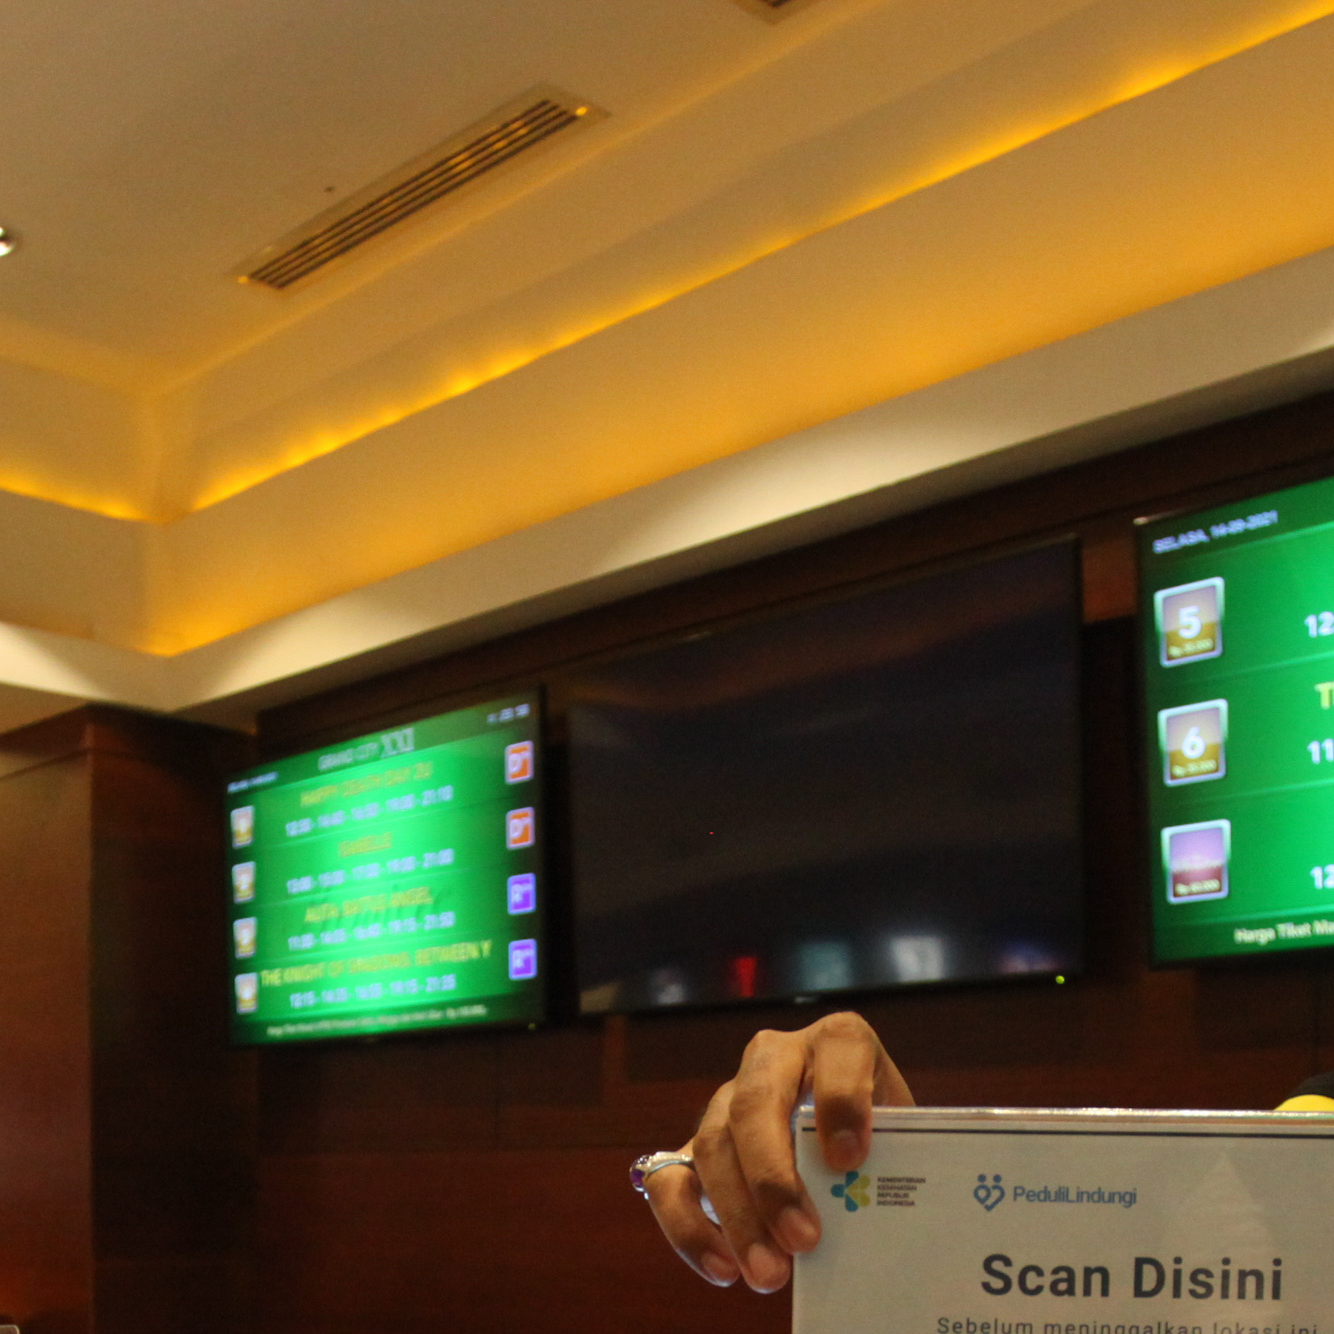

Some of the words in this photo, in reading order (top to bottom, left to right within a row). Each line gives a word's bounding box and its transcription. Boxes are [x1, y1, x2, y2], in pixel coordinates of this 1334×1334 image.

[1178, 605, 1202, 639] 5
[1182, 726, 1207, 759] 6
[1013, 1186, 1137, 1208] PeduliLindungi
[982, 1254, 1110, 1297] Scan
[1133, 1257, 1282, 1300] Disini
[937, 1317, 1033, 1334] Sebelum
